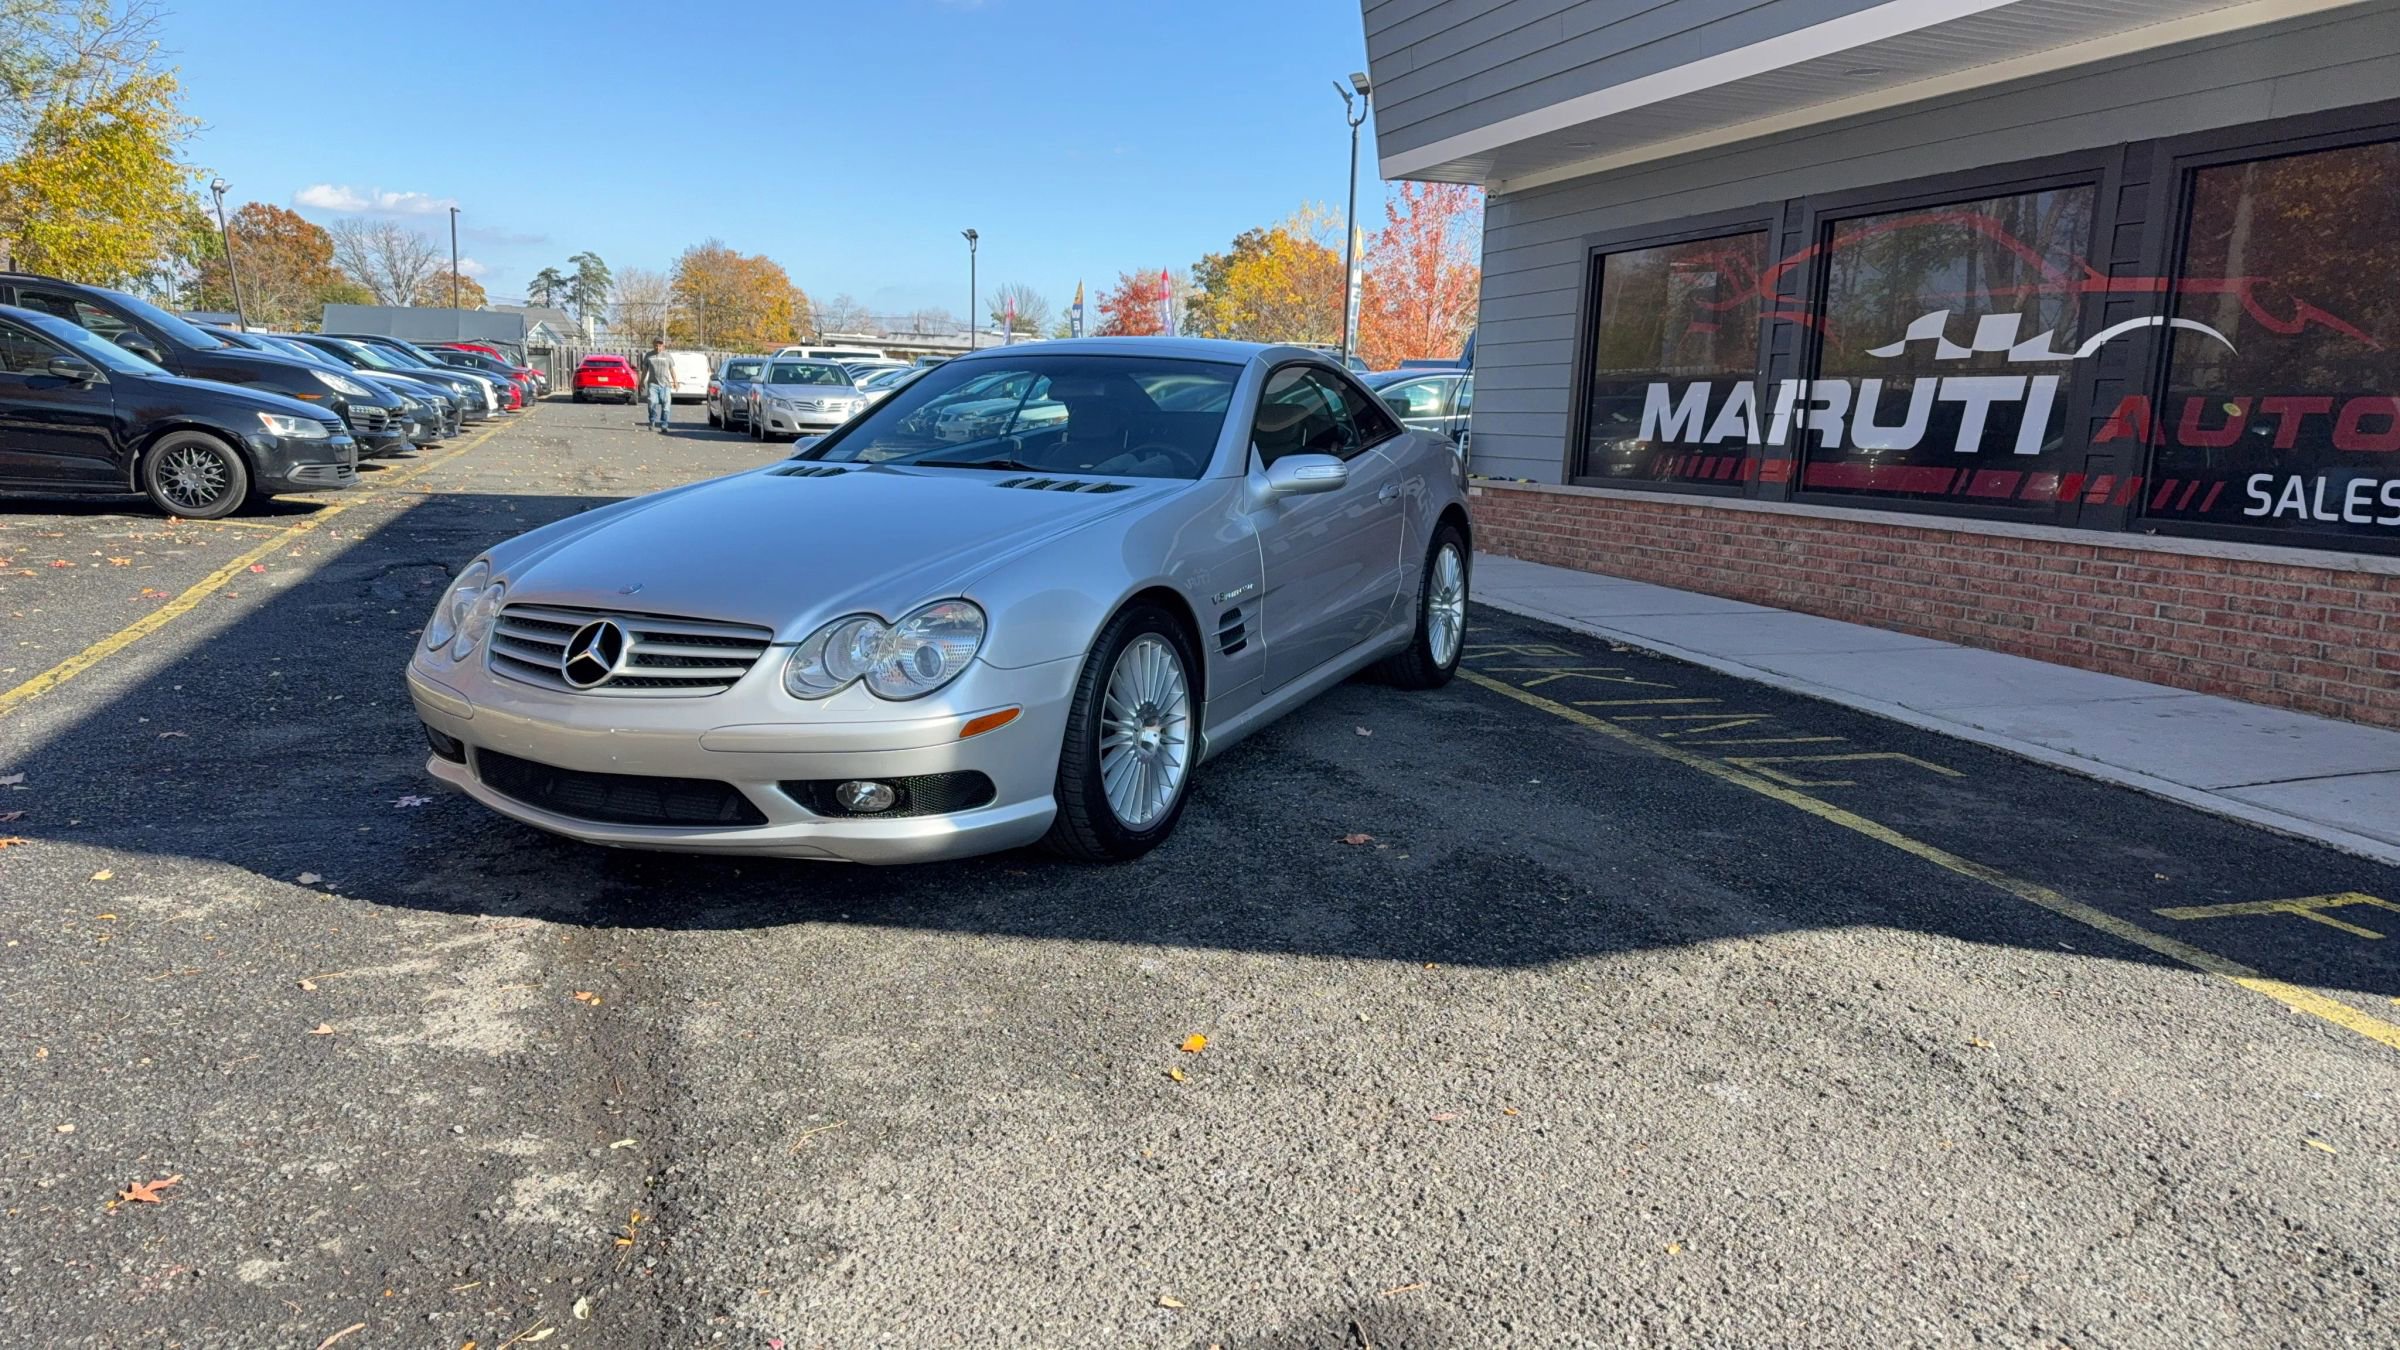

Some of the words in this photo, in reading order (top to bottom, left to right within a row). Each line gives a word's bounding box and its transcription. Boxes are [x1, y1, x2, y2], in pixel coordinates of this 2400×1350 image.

[1638, 374, 2060, 455] MARUTI
[2092, 395, 2400, 451] AUTO
[2243, 472, 2400, 526] SALES
[1464, 627, 1968, 788] RKING
